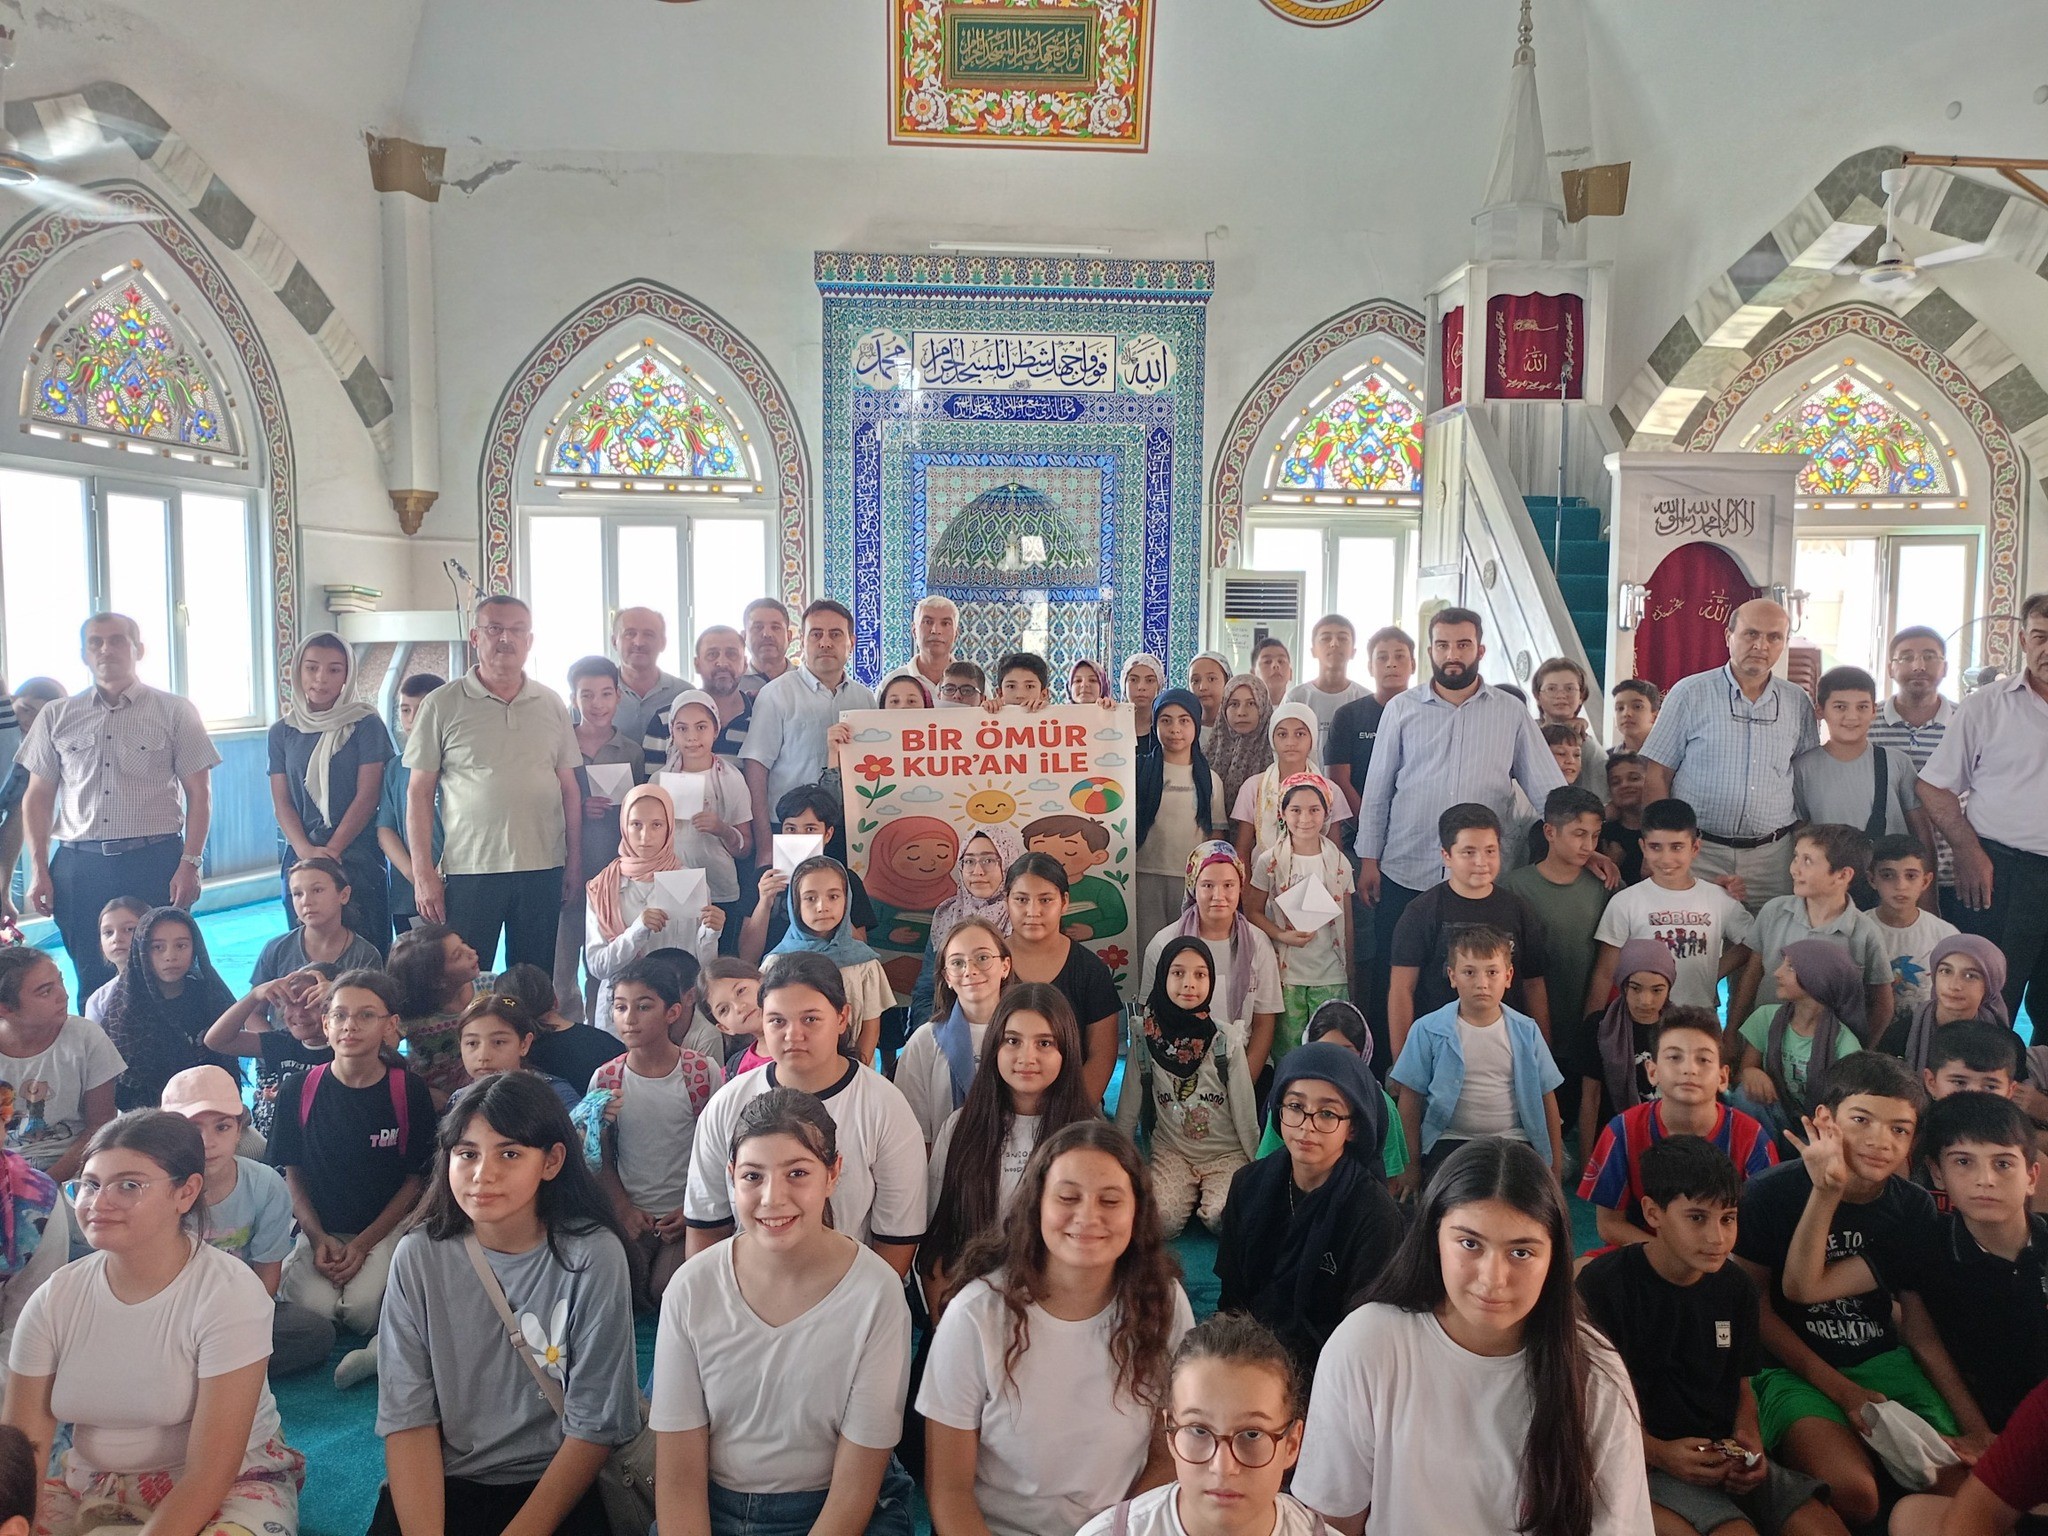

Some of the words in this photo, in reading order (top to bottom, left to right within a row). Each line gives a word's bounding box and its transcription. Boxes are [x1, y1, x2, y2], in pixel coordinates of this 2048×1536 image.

[1124, 338, 1168, 390] الله
[1522, 346, 1548, 373] الله
[902, 723, 963, 751] BİR
[975, 719, 1087, 749] ÖMÜR
[1648, 910, 1712, 927] ROBLOX
